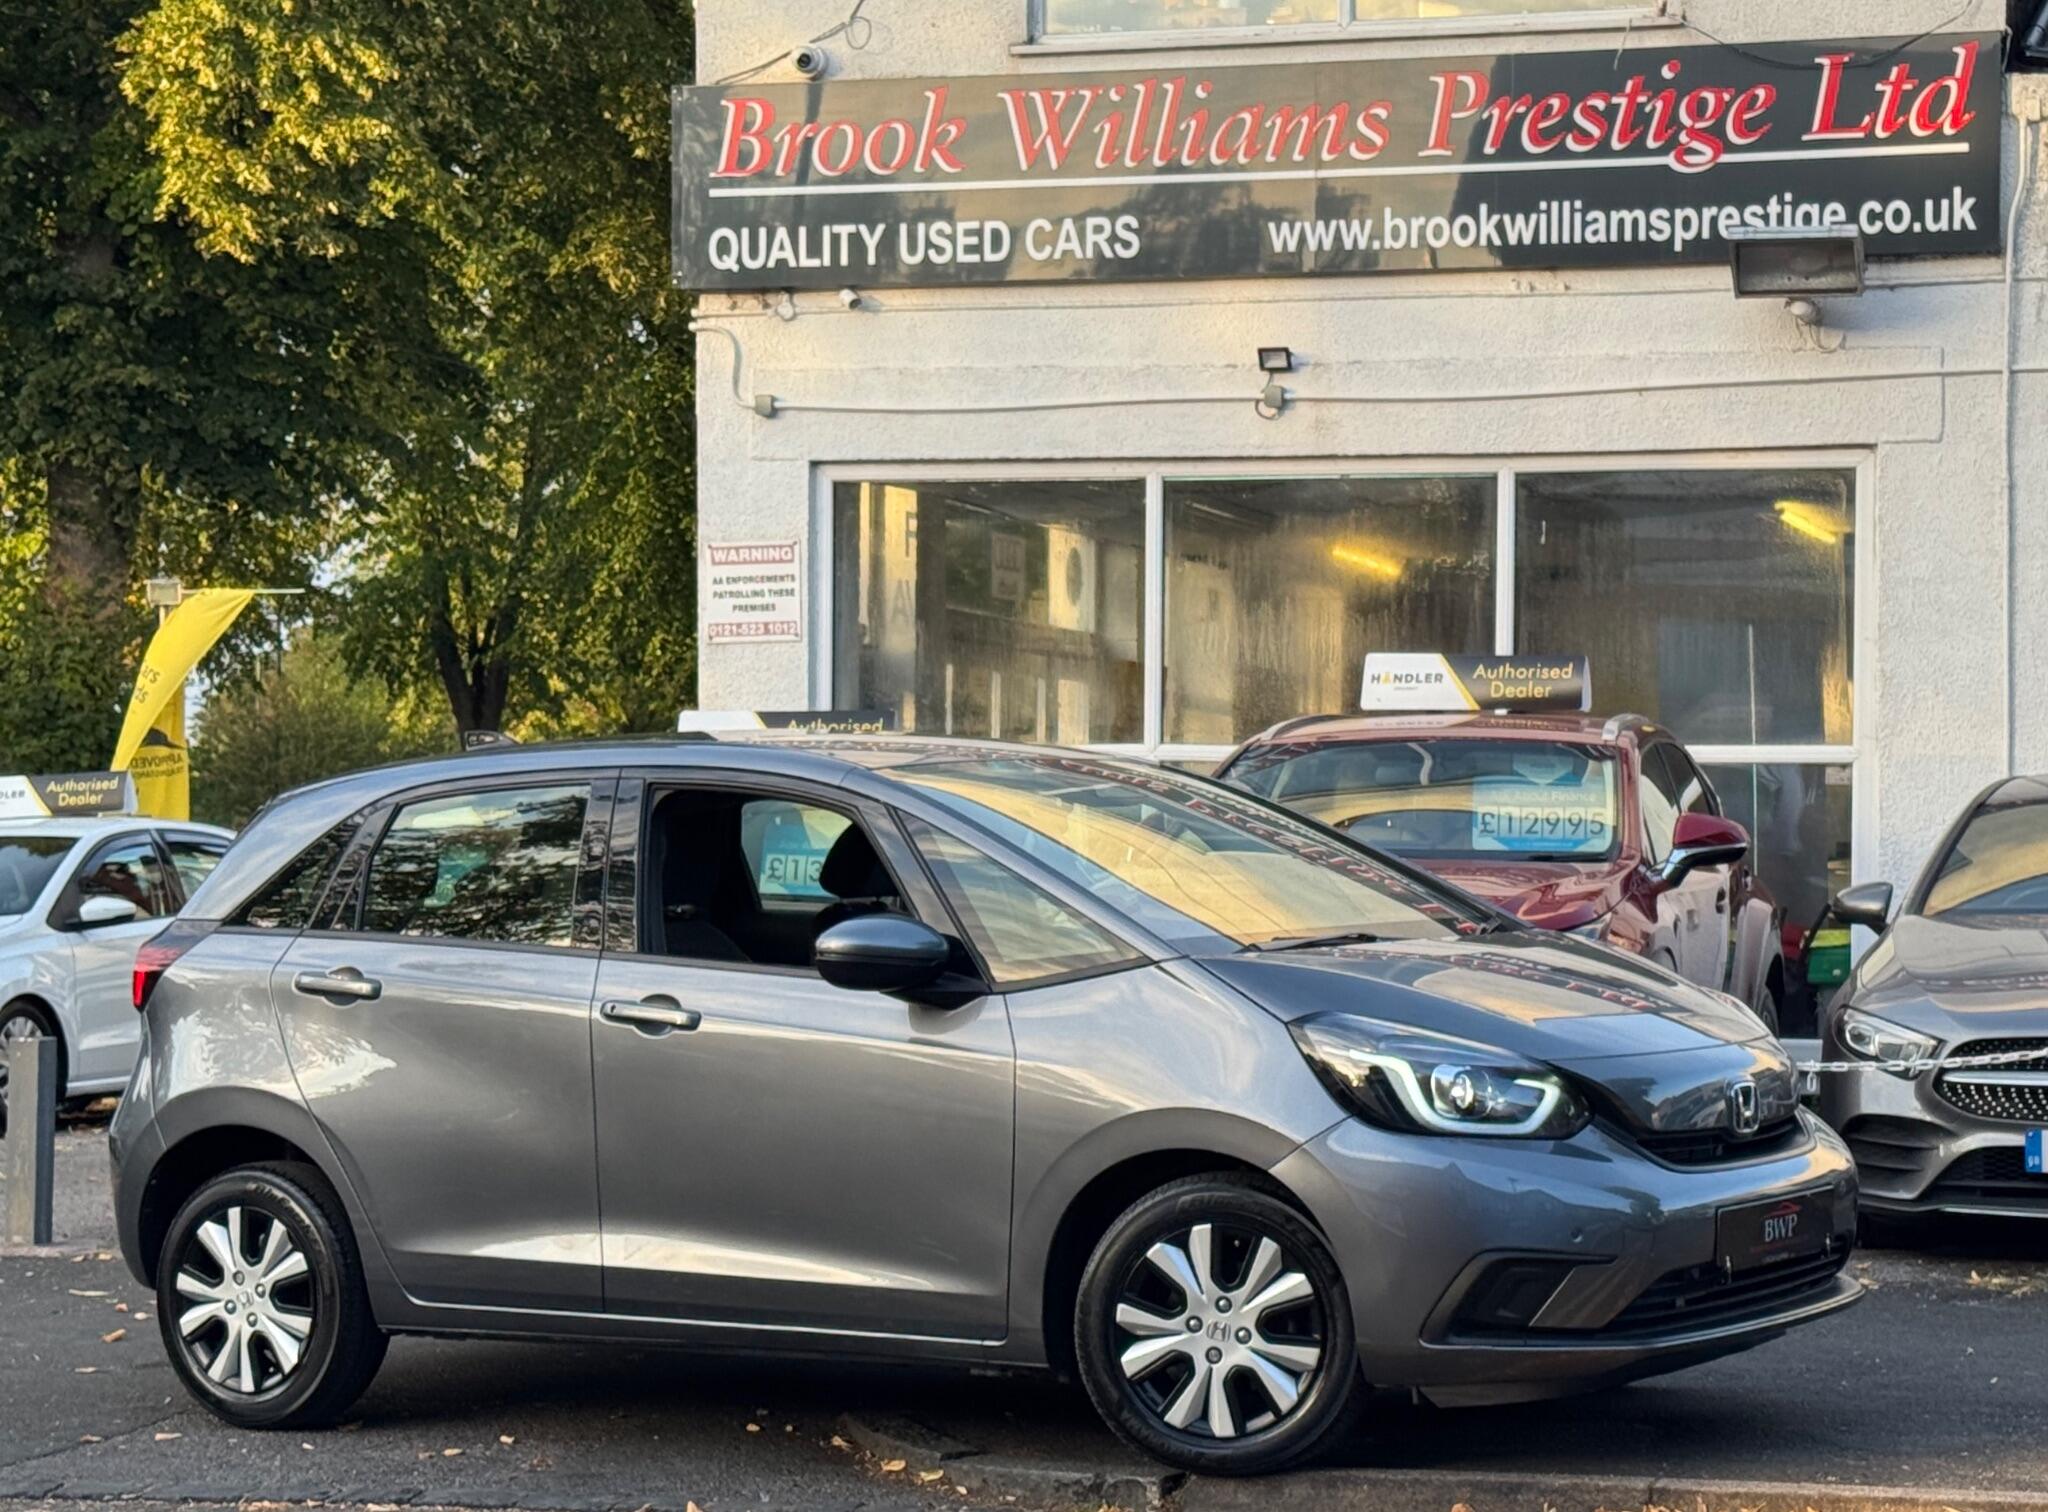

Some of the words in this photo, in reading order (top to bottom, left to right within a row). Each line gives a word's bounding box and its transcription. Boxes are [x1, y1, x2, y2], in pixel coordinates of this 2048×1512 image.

[709, 86, 968, 179] Brook
[997, 76, 1391, 172] Williams
[1418, 59, 1776, 174] Prestige
[1802, 40, 1980, 142] Ltd
[708, 223, 885, 273] QUALITY
[900, 219, 1011, 266] USED
[1024, 215, 1141, 260] CARS
[712, 547, 793, 563] WARNING
[726, 574, 796, 585] ENFORCEMENTS
[713, 589, 766, 599] PATROLLING
[768, 588, 796, 597] THESE
[732, 603, 776, 613] PREMISES
[1473, 662, 1573, 680] Authorised
[1490, 681, 1552, 698] Dealer
[788, 717, 884, 733] Authorised
[46, 775, 119, 793] Authorised
[58, 791, 103, 807] Dealer
[1480, 811, 1605, 836] £12995
[767, 857, 823, 883] £13
[1764, 1213, 1798, 1242] BWP
